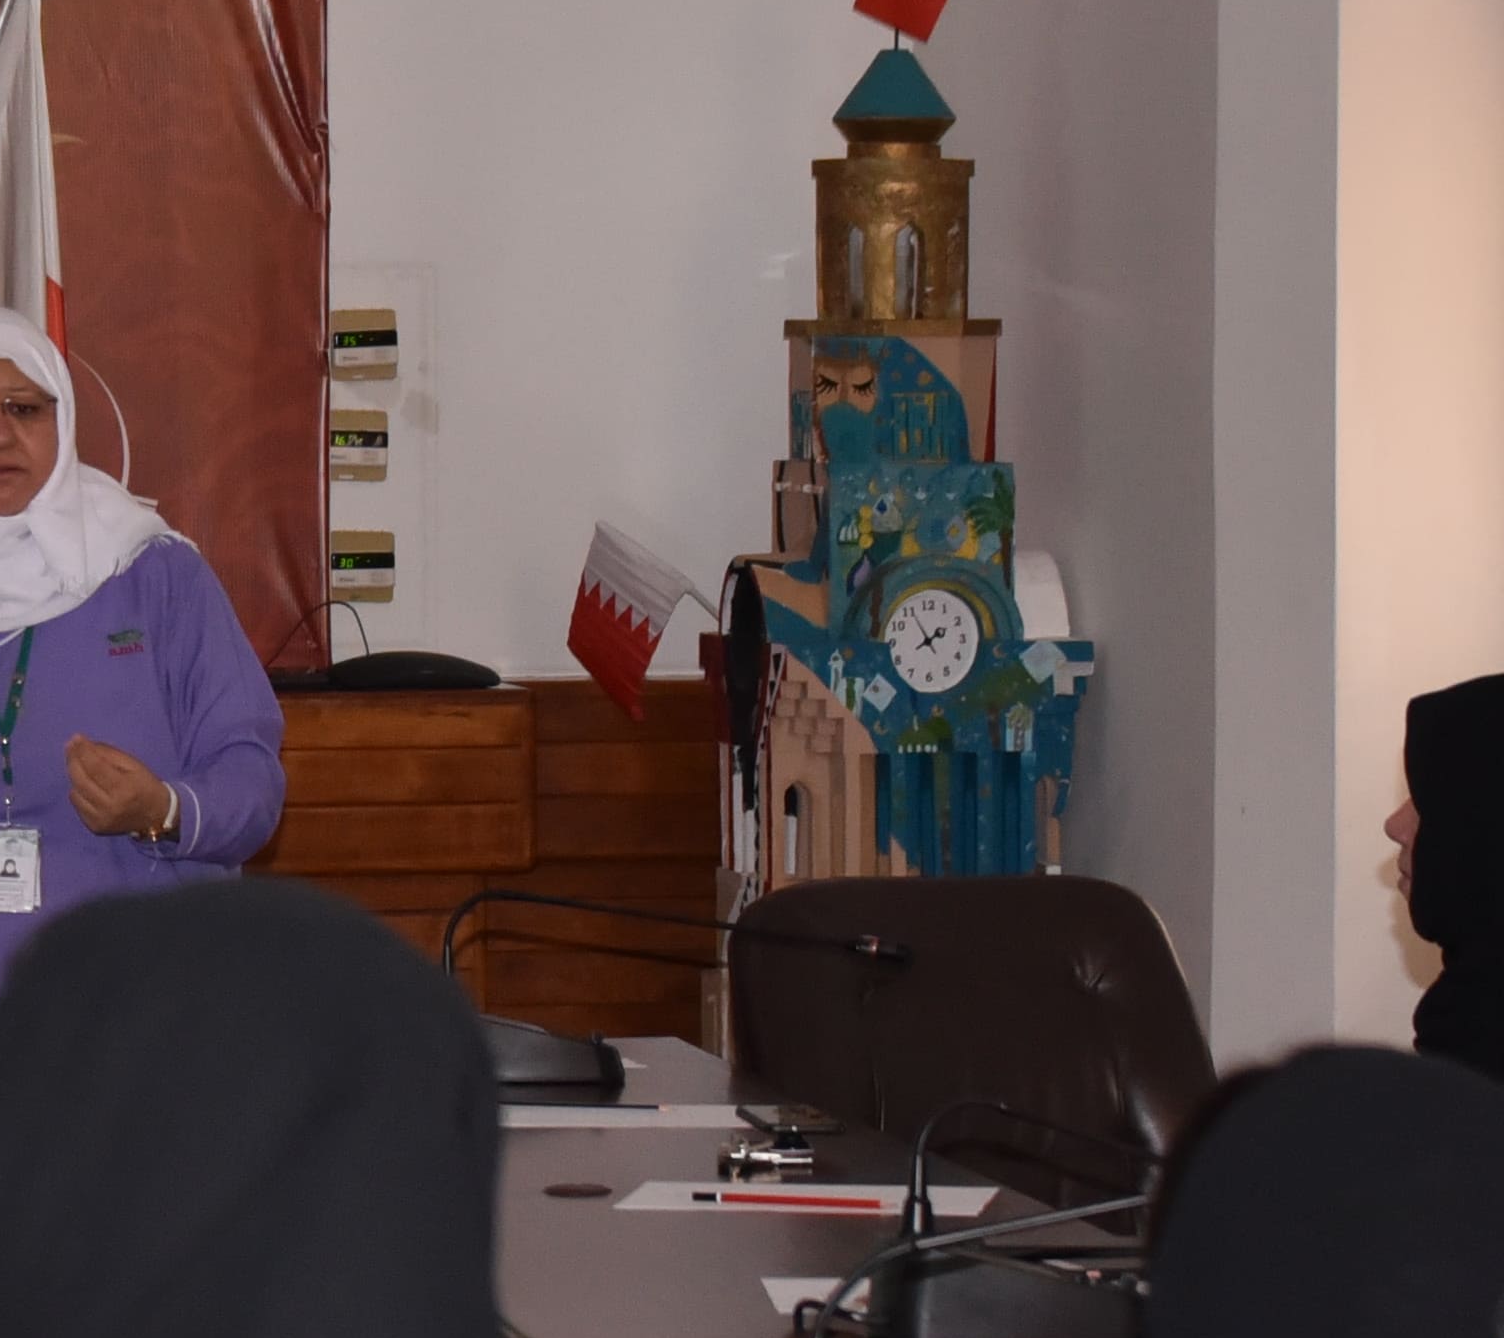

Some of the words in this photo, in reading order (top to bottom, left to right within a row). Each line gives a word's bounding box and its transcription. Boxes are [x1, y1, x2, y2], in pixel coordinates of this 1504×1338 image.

[922, 600, 935, 611] 12
[942, 603, 947, 614] 1
[902, 606, 915, 617] 11
[892, 621, 905, 632] 10
[954, 616, 961, 627] 2
[907, 668, 914, 678] 7
[926, 672, 933, 682] 6
[943, 666, 950, 677] 5
